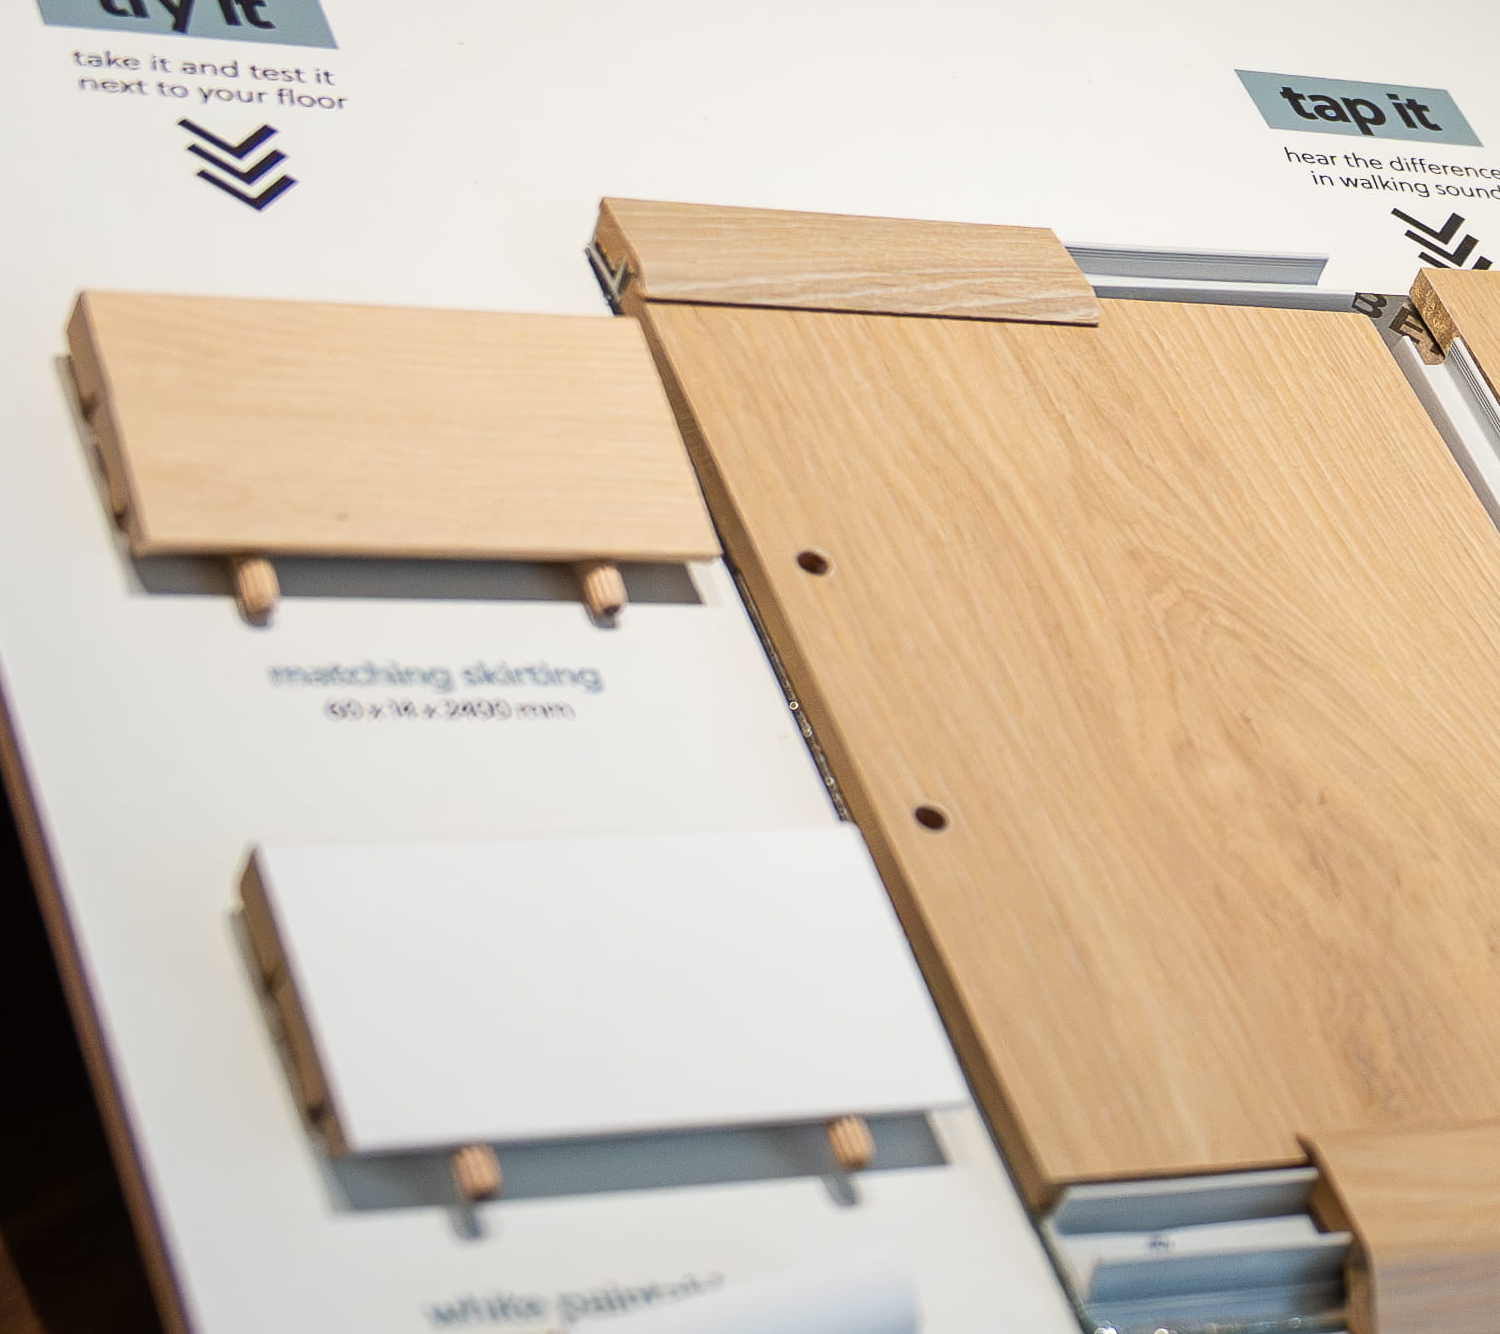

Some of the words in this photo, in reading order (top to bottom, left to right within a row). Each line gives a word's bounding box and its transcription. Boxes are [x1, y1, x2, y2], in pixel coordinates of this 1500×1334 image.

[73, 51, 140, 71] take
[151, 54, 171, 74] it
[181, 60, 239, 79] and
[250, 64, 306, 84] test
[315, 67, 336, 87] it
[78, 77, 148, 97] next
[157, 81, 189, 100] to
[198, 85, 268, 105] your
[277, 88, 349, 111] floor
[1279, 87, 1387, 137] tap
[1385, 93, 1444, 132] it
[1284, 147, 1338, 166] hear
[1344, 153, 1383, 171] the
[1311, 171, 1334, 187] in
[1340, 175, 1430, 198] walking
[266, 660, 456, 695] matching
